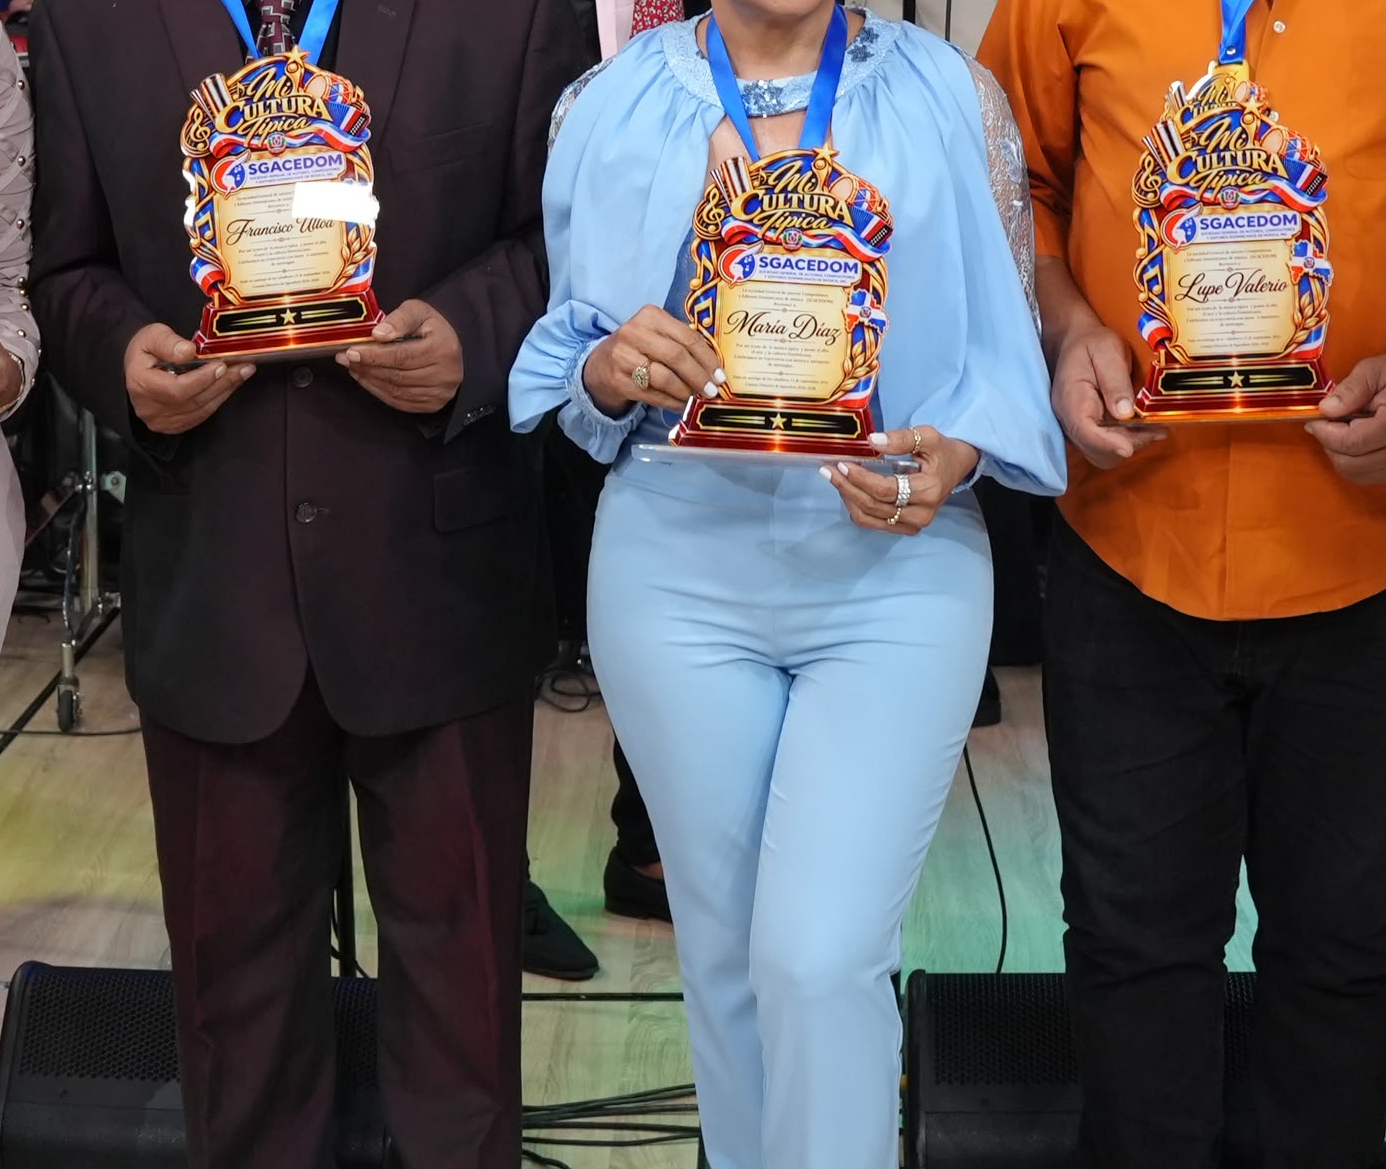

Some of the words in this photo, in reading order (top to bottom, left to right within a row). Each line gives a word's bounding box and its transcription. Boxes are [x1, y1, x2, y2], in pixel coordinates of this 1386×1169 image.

[246, 67, 292, 103] Mi
[215, 96, 333, 133] CULTURA
[1199, 117, 1246, 153] Mi
[248, 154, 343, 175] SGACEDOM
[768, 160, 816, 193] Mi
[1167, 150, 1289, 185] CULTURA
[731, 189, 854, 227] CULTURA
[1199, 213, 1297, 230] SGACEDOM
[226, 218, 293, 245] Francisco
[759, 256, 859, 274] SGACEDOM
[1174, 272, 1224, 304] Lupe
[1225, 268, 1288, 298] Valerio
[724, 310, 788, 337] María
[788, 313, 842, 346] Díaz
